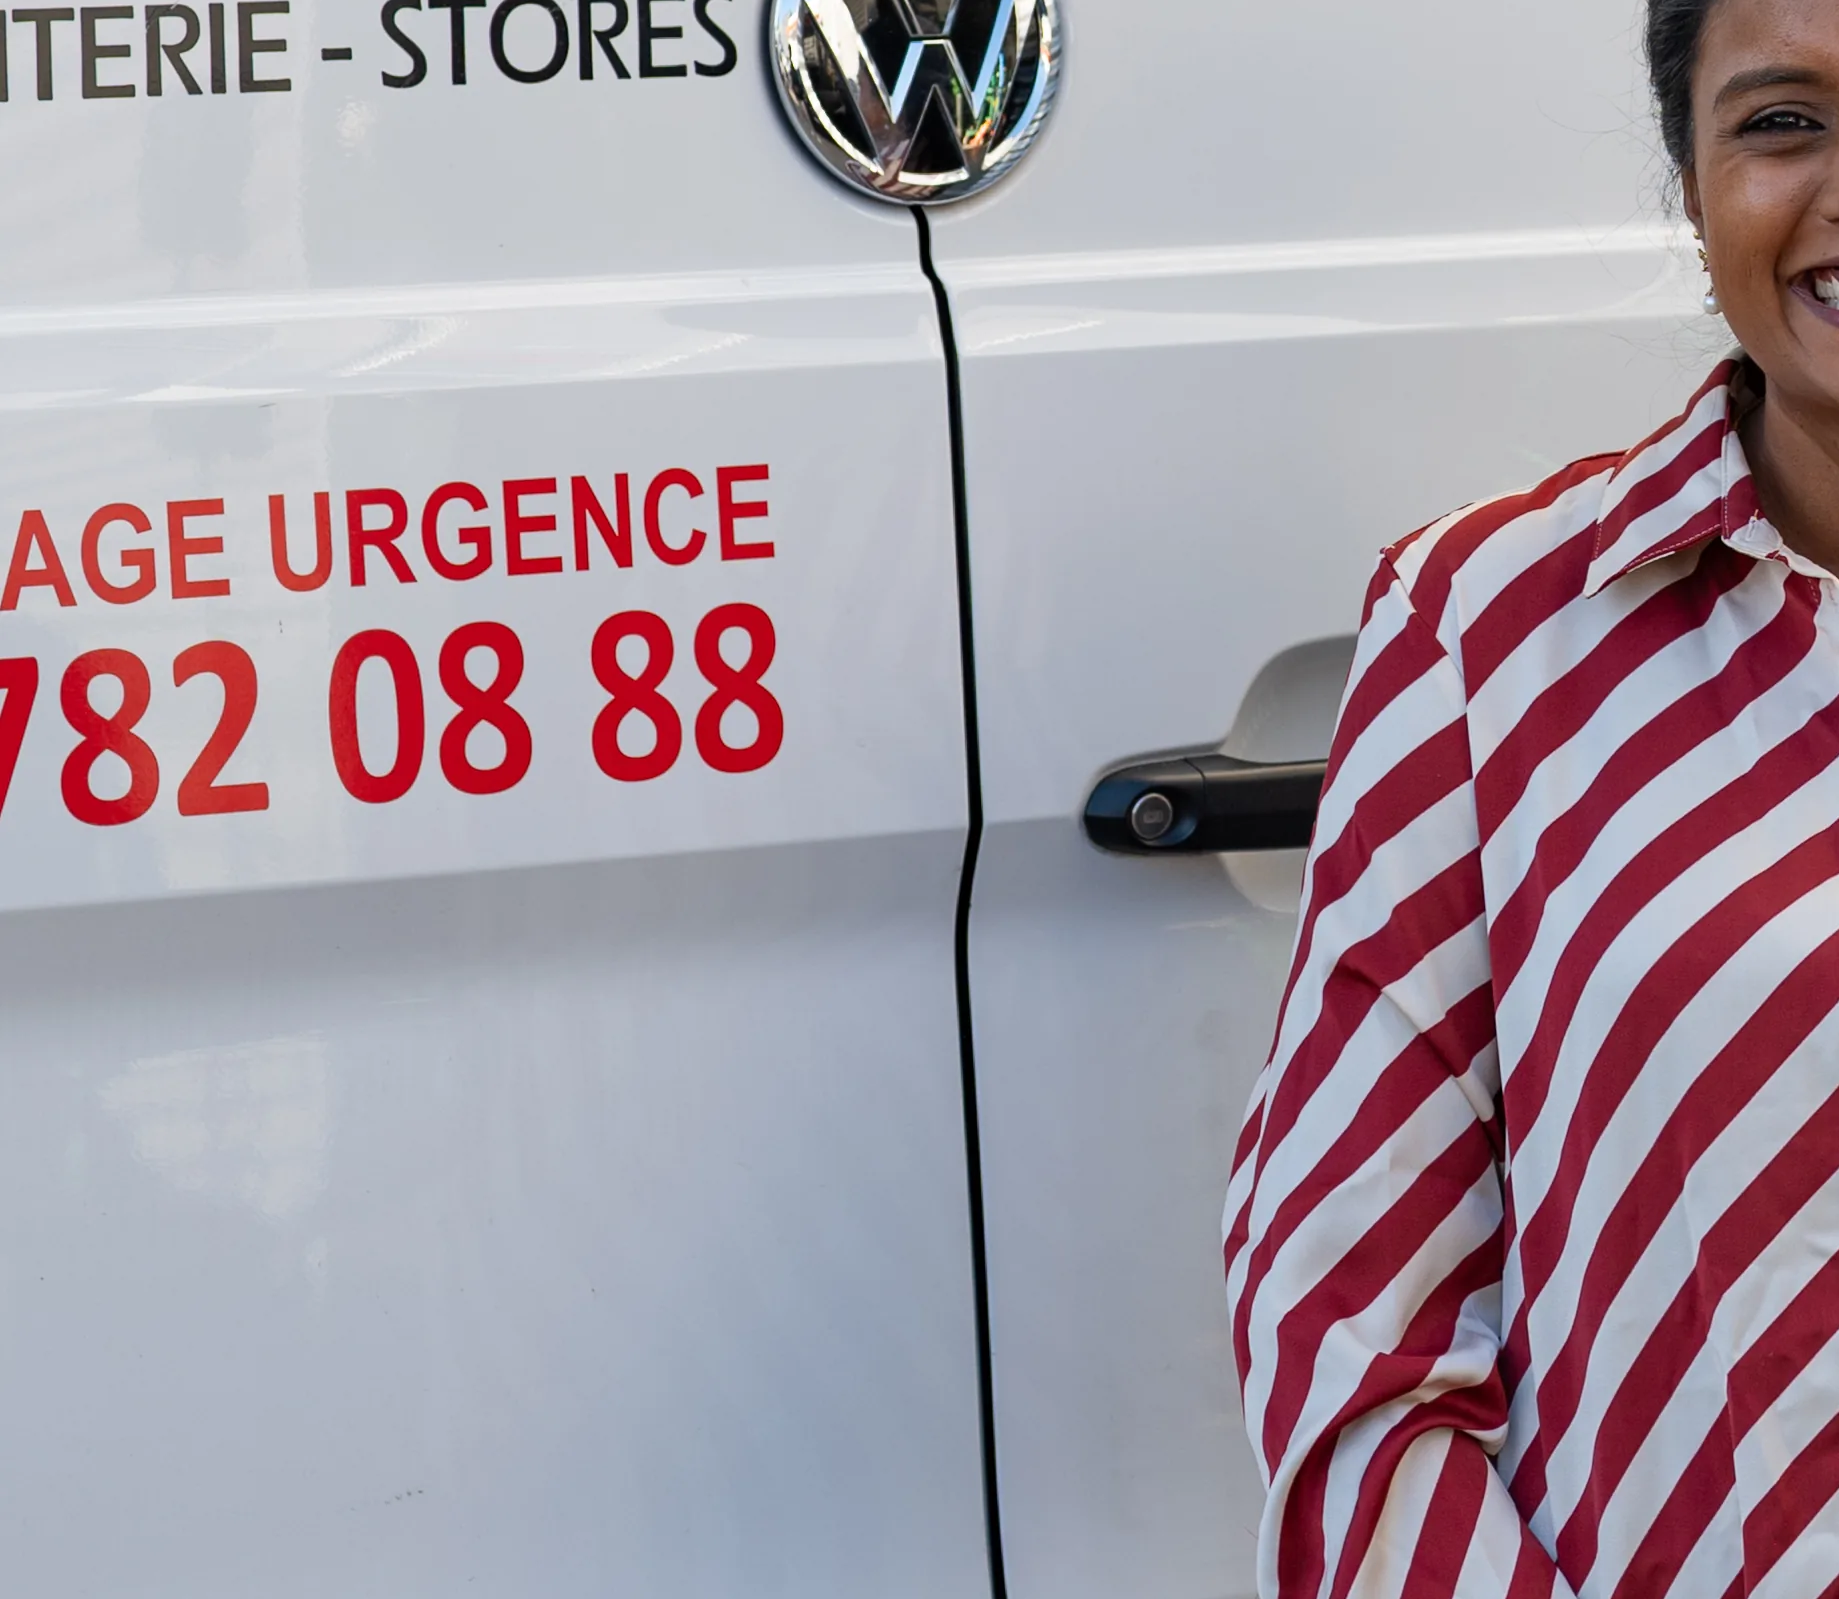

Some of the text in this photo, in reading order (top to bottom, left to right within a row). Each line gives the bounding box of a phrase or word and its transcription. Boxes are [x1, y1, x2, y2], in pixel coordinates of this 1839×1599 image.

[0, 1, 291, 102] TERIE
[0, 464, 774, 611] AGE URGENCE
[329, 621, 532, 803] 08
[591, 603, 783, 782] 88
